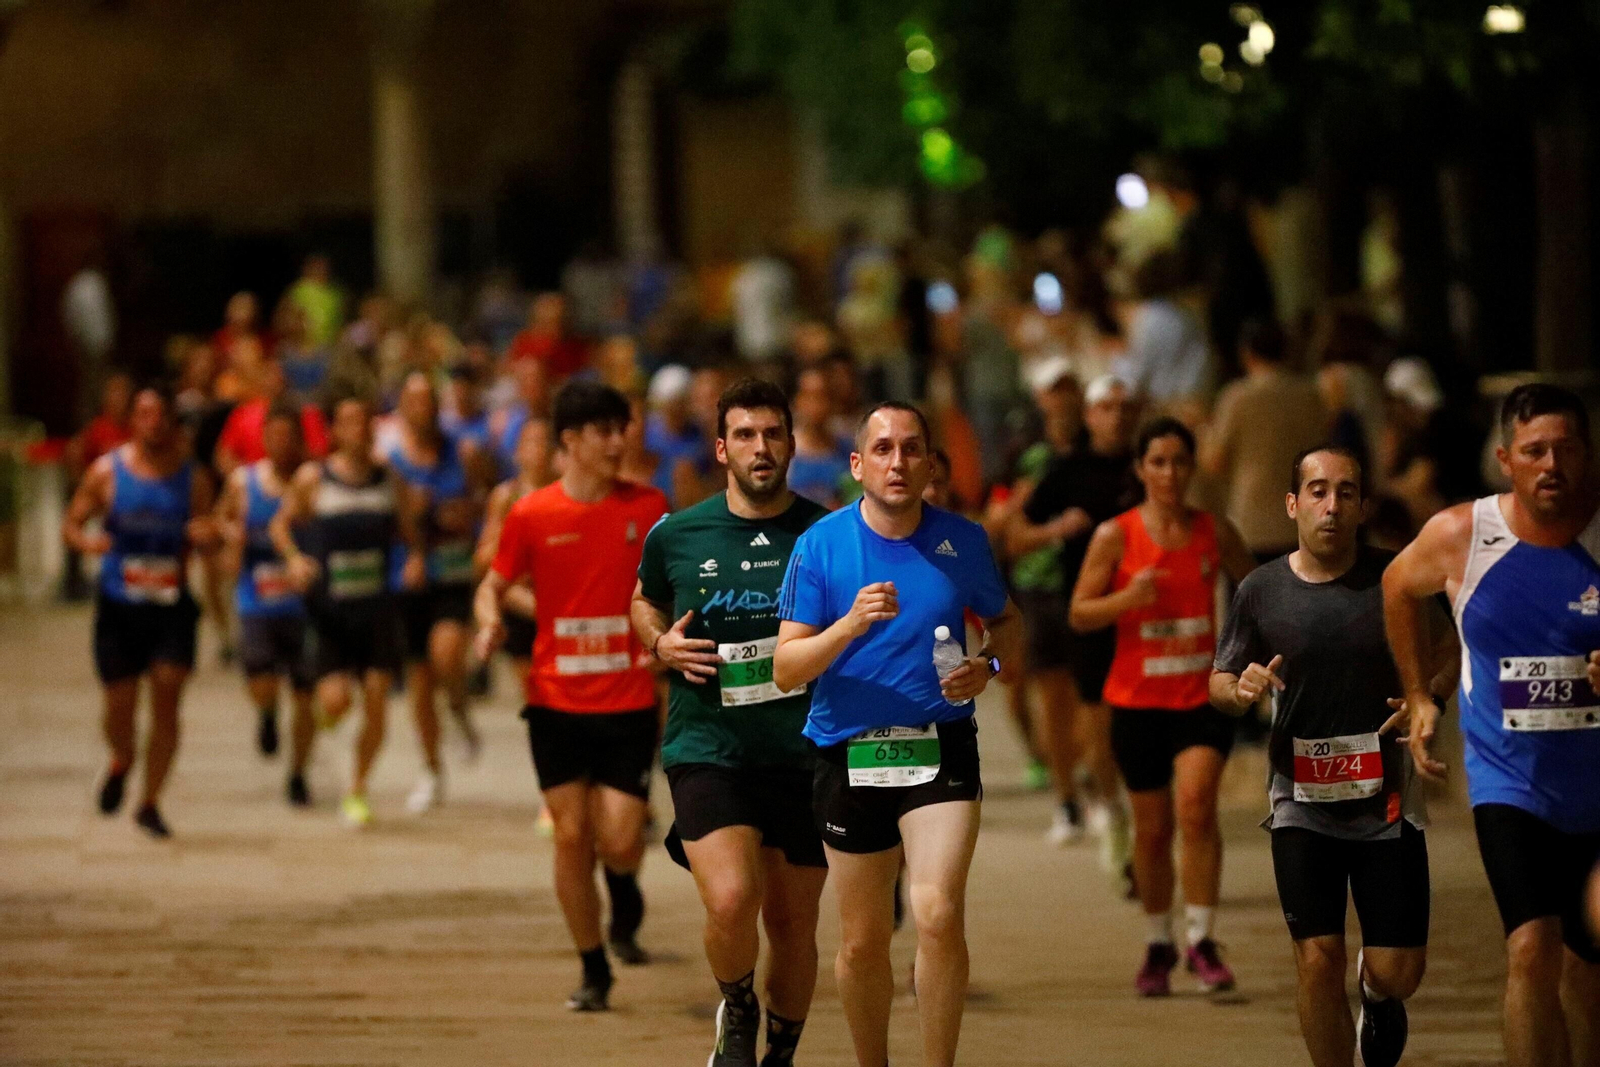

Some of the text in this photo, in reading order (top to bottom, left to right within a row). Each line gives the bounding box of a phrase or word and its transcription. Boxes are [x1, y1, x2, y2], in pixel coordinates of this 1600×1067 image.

[753, 560, 780, 568] ZURICH
[742, 645, 758, 659] 20
[745, 660, 774, 680] 56
[1528, 661, 1546, 676] 20
[1528, 680, 1573, 702] 943
[875, 741, 914, 760] 655
[1313, 742, 1330, 756] 20
[1312, 755, 1363, 778] 1724
